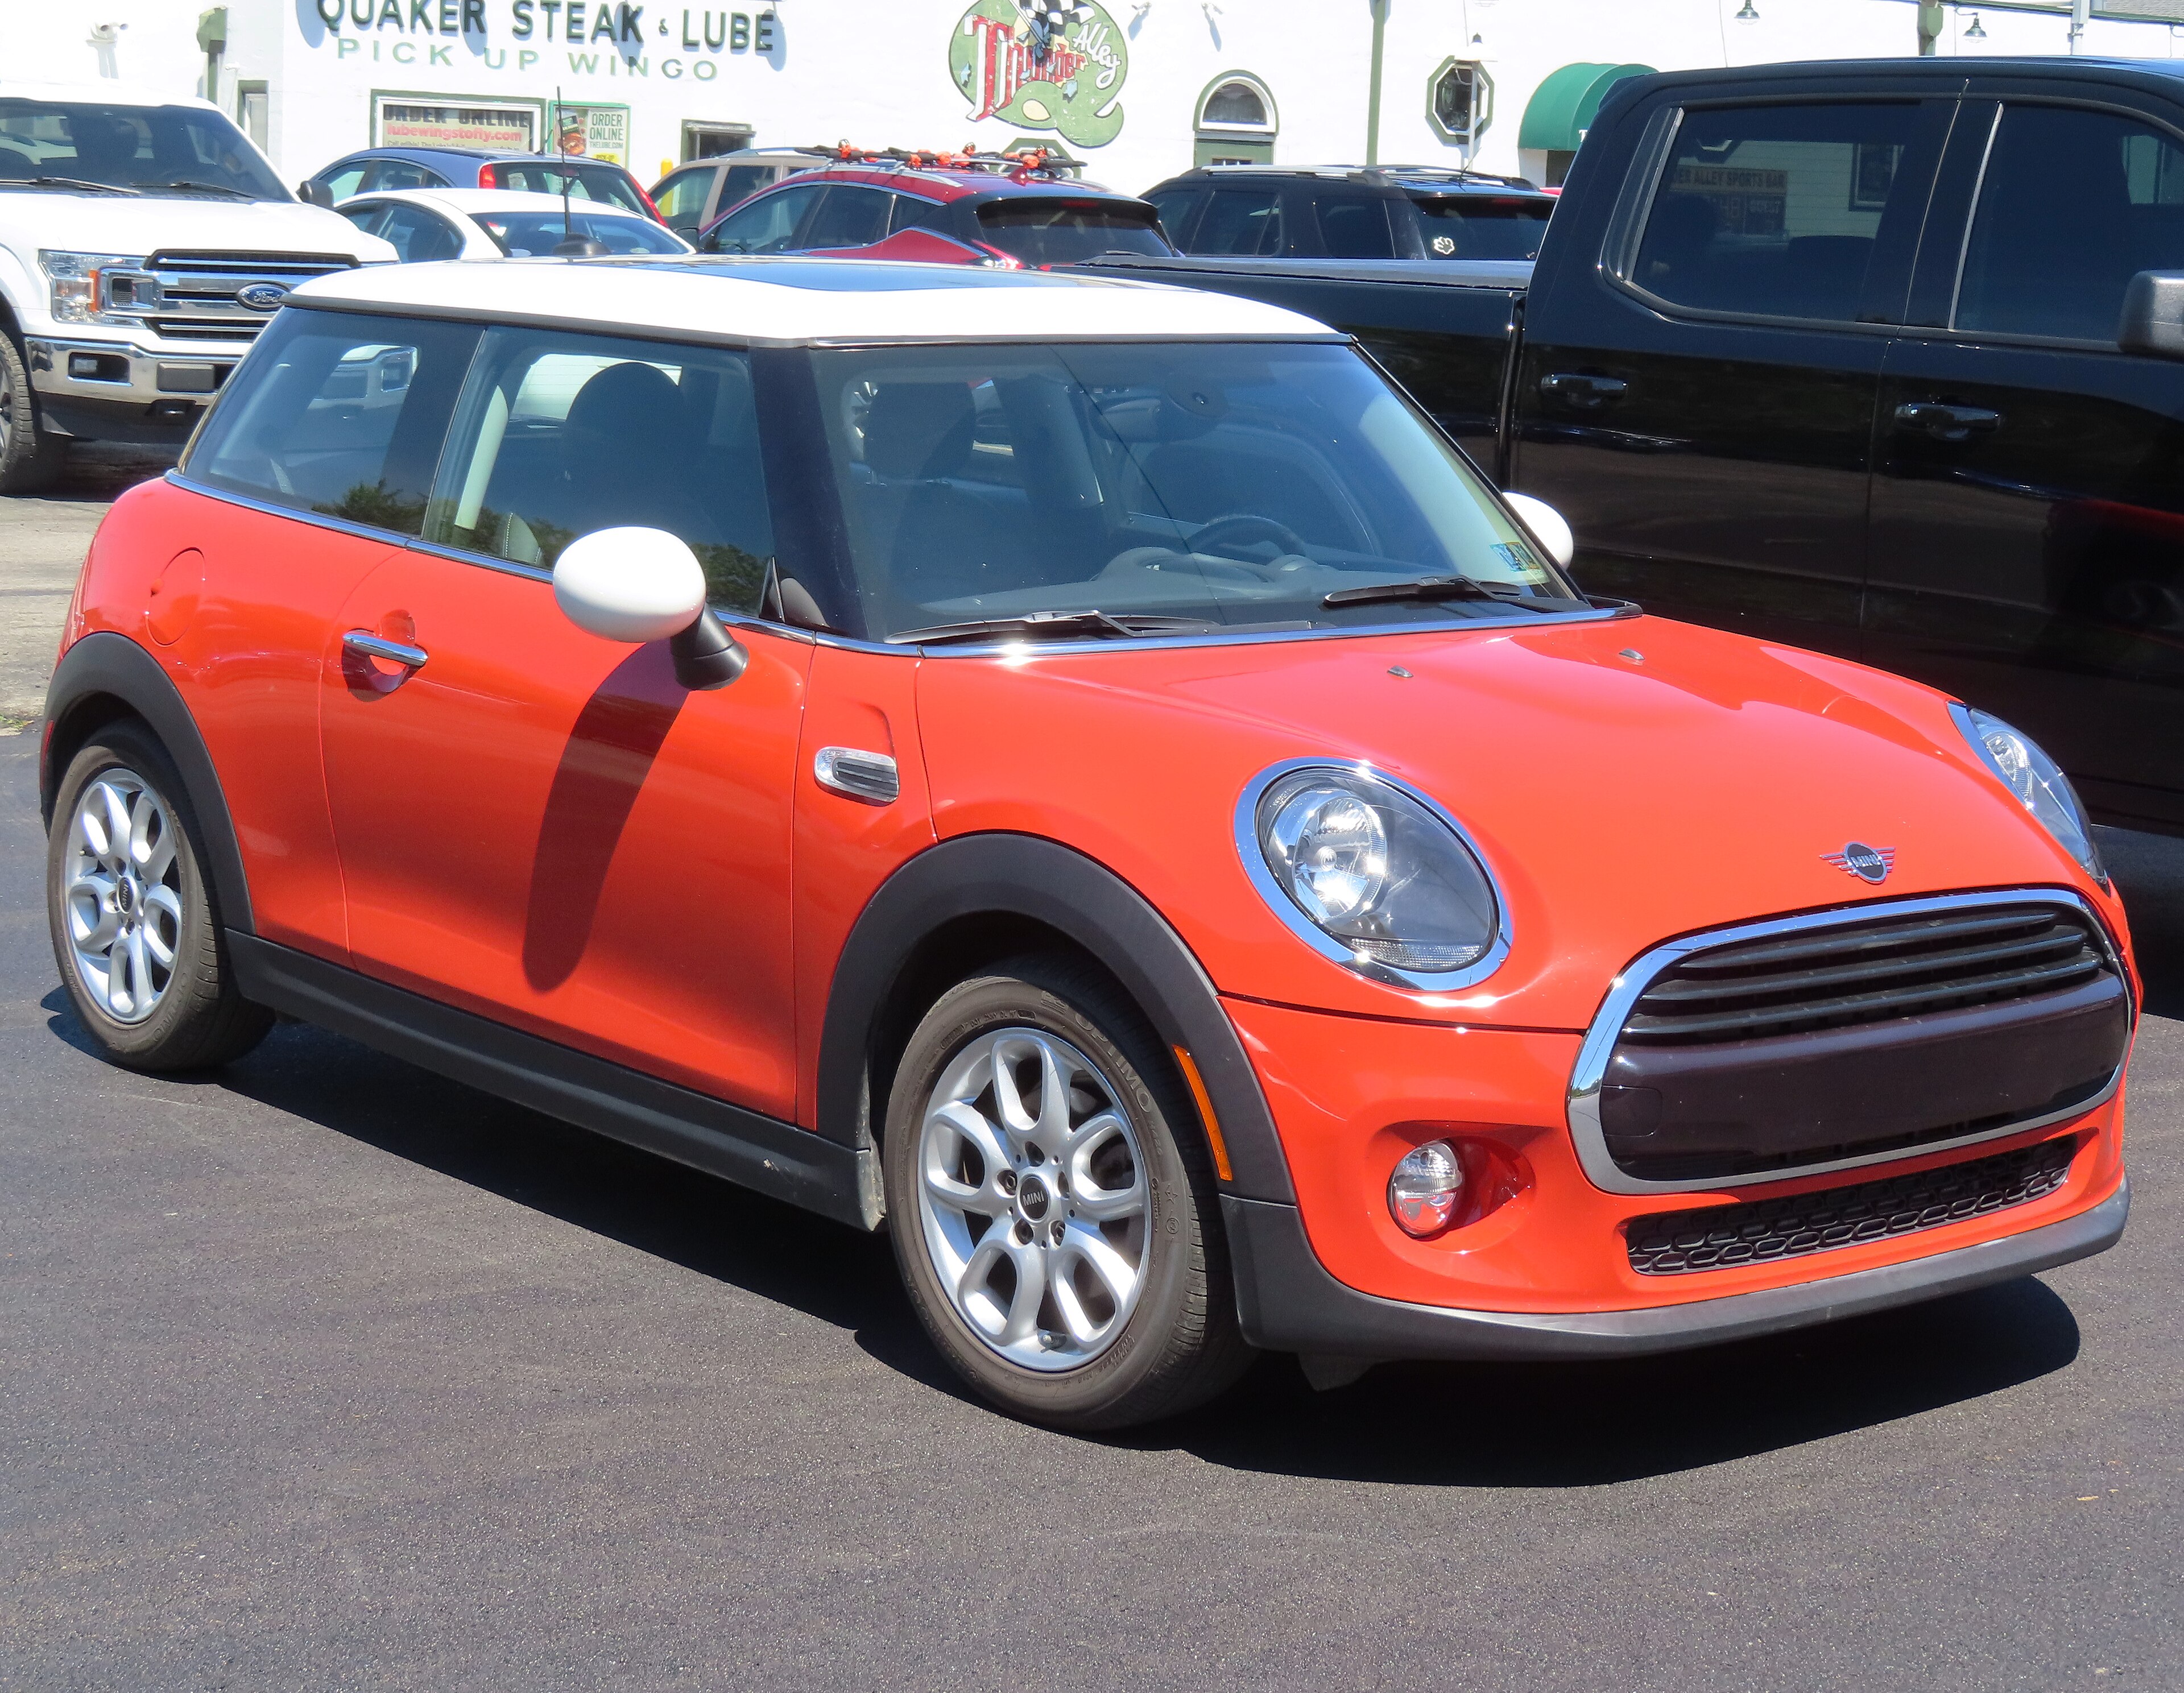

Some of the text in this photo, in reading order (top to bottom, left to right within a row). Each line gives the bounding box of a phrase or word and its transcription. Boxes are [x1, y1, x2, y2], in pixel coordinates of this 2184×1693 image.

[318, 0, 774, 52] QUAKER STEAK & LUBE
[338, 38, 453, 67] PICK
[484, 47, 539, 71] UP
[1072, 22, 1120, 89] Alley
[592, 113, 623, 126] ORDER
[590, 127, 624, 140] ONLINE
[254, 291, 280, 303] Ford
[1850, 854, 1881, 868] MINI
[1023, 1190, 1045, 1206] MINI
